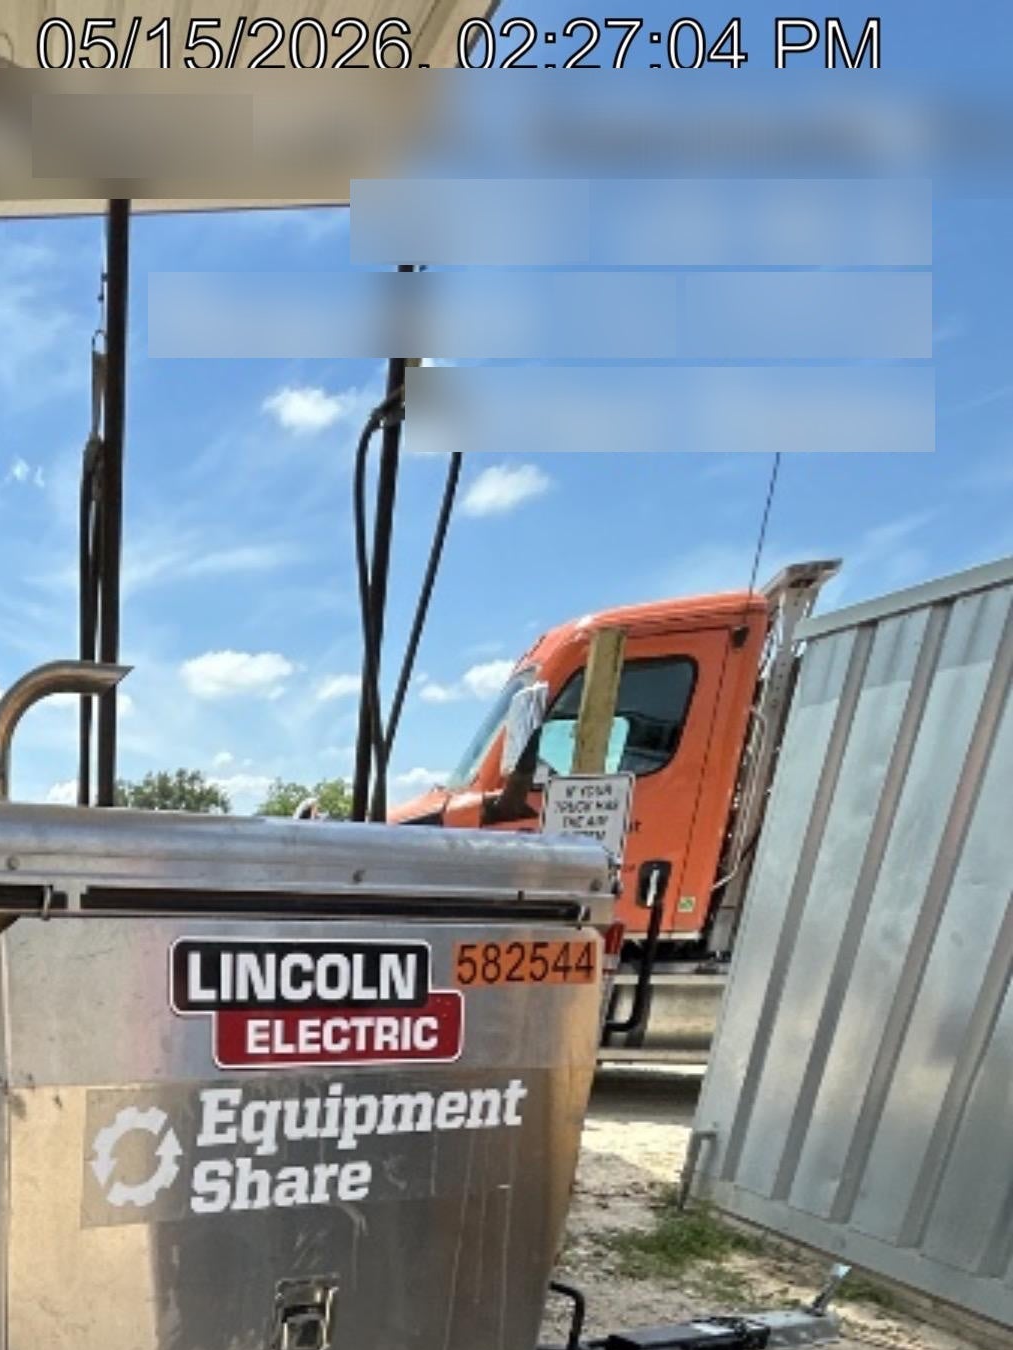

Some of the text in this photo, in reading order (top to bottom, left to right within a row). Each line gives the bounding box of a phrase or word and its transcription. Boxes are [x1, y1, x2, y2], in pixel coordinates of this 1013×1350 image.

[188, 951, 417, 1001] LINCOLN
[457, 941, 594, 984] 582544
[246, 1016, 438, 1054] ELECTRIC
[196, 1079, 527, 1155] Equipment
[191, 1158, 372, 1213] Share
